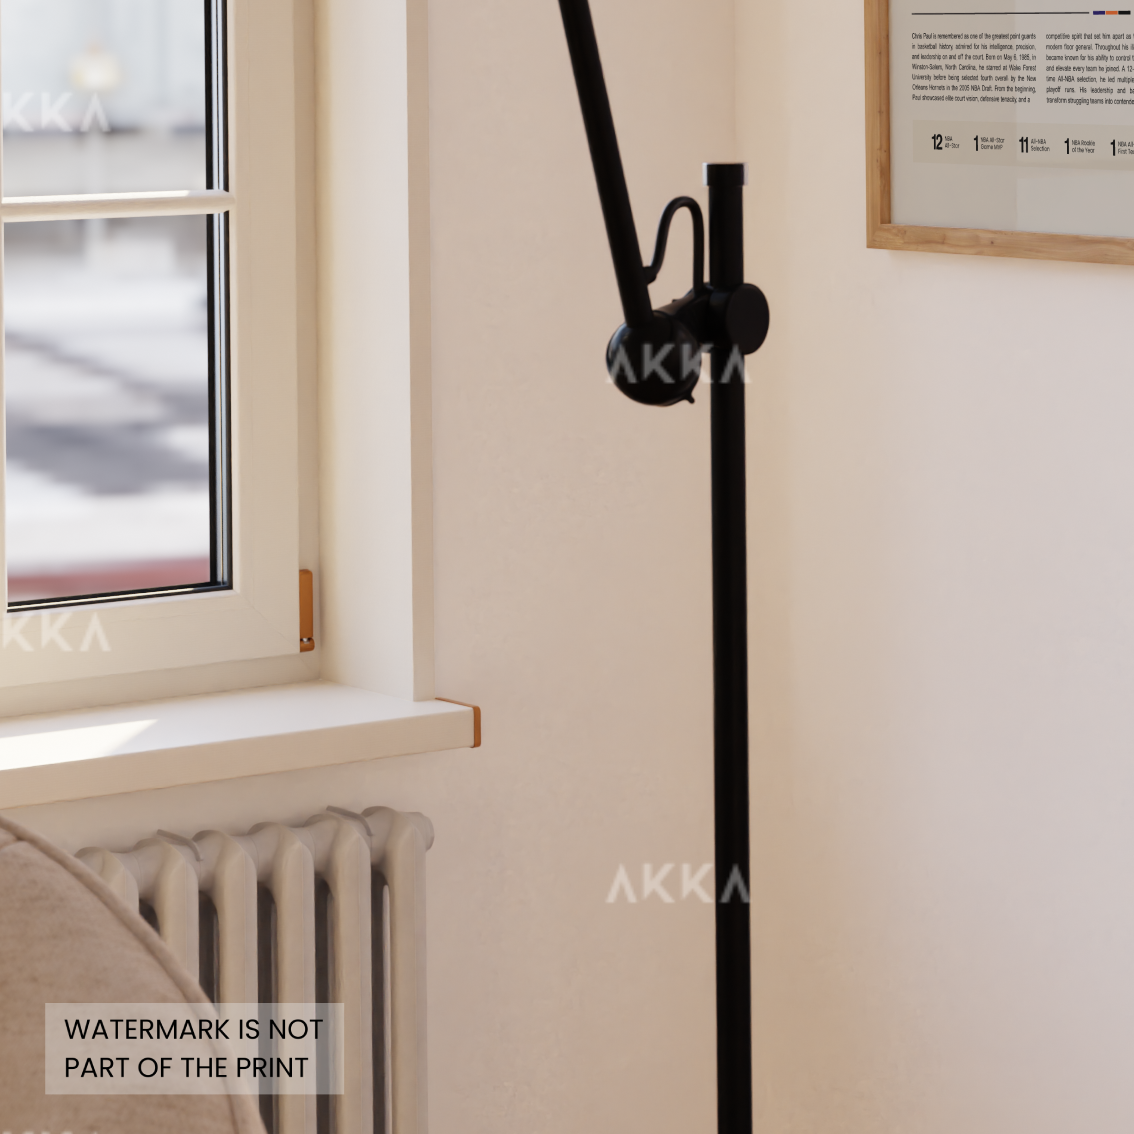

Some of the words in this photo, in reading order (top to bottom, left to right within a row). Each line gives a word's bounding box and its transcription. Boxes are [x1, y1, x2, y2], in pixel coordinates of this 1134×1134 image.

[932, 134, 943, 150] 12
[974, 135, 978, 151] 1
[1019, 136, 1028, 153] 11
[1064, 138, 1069, 154] 1
[1110, 139, 1116, 156] 1
